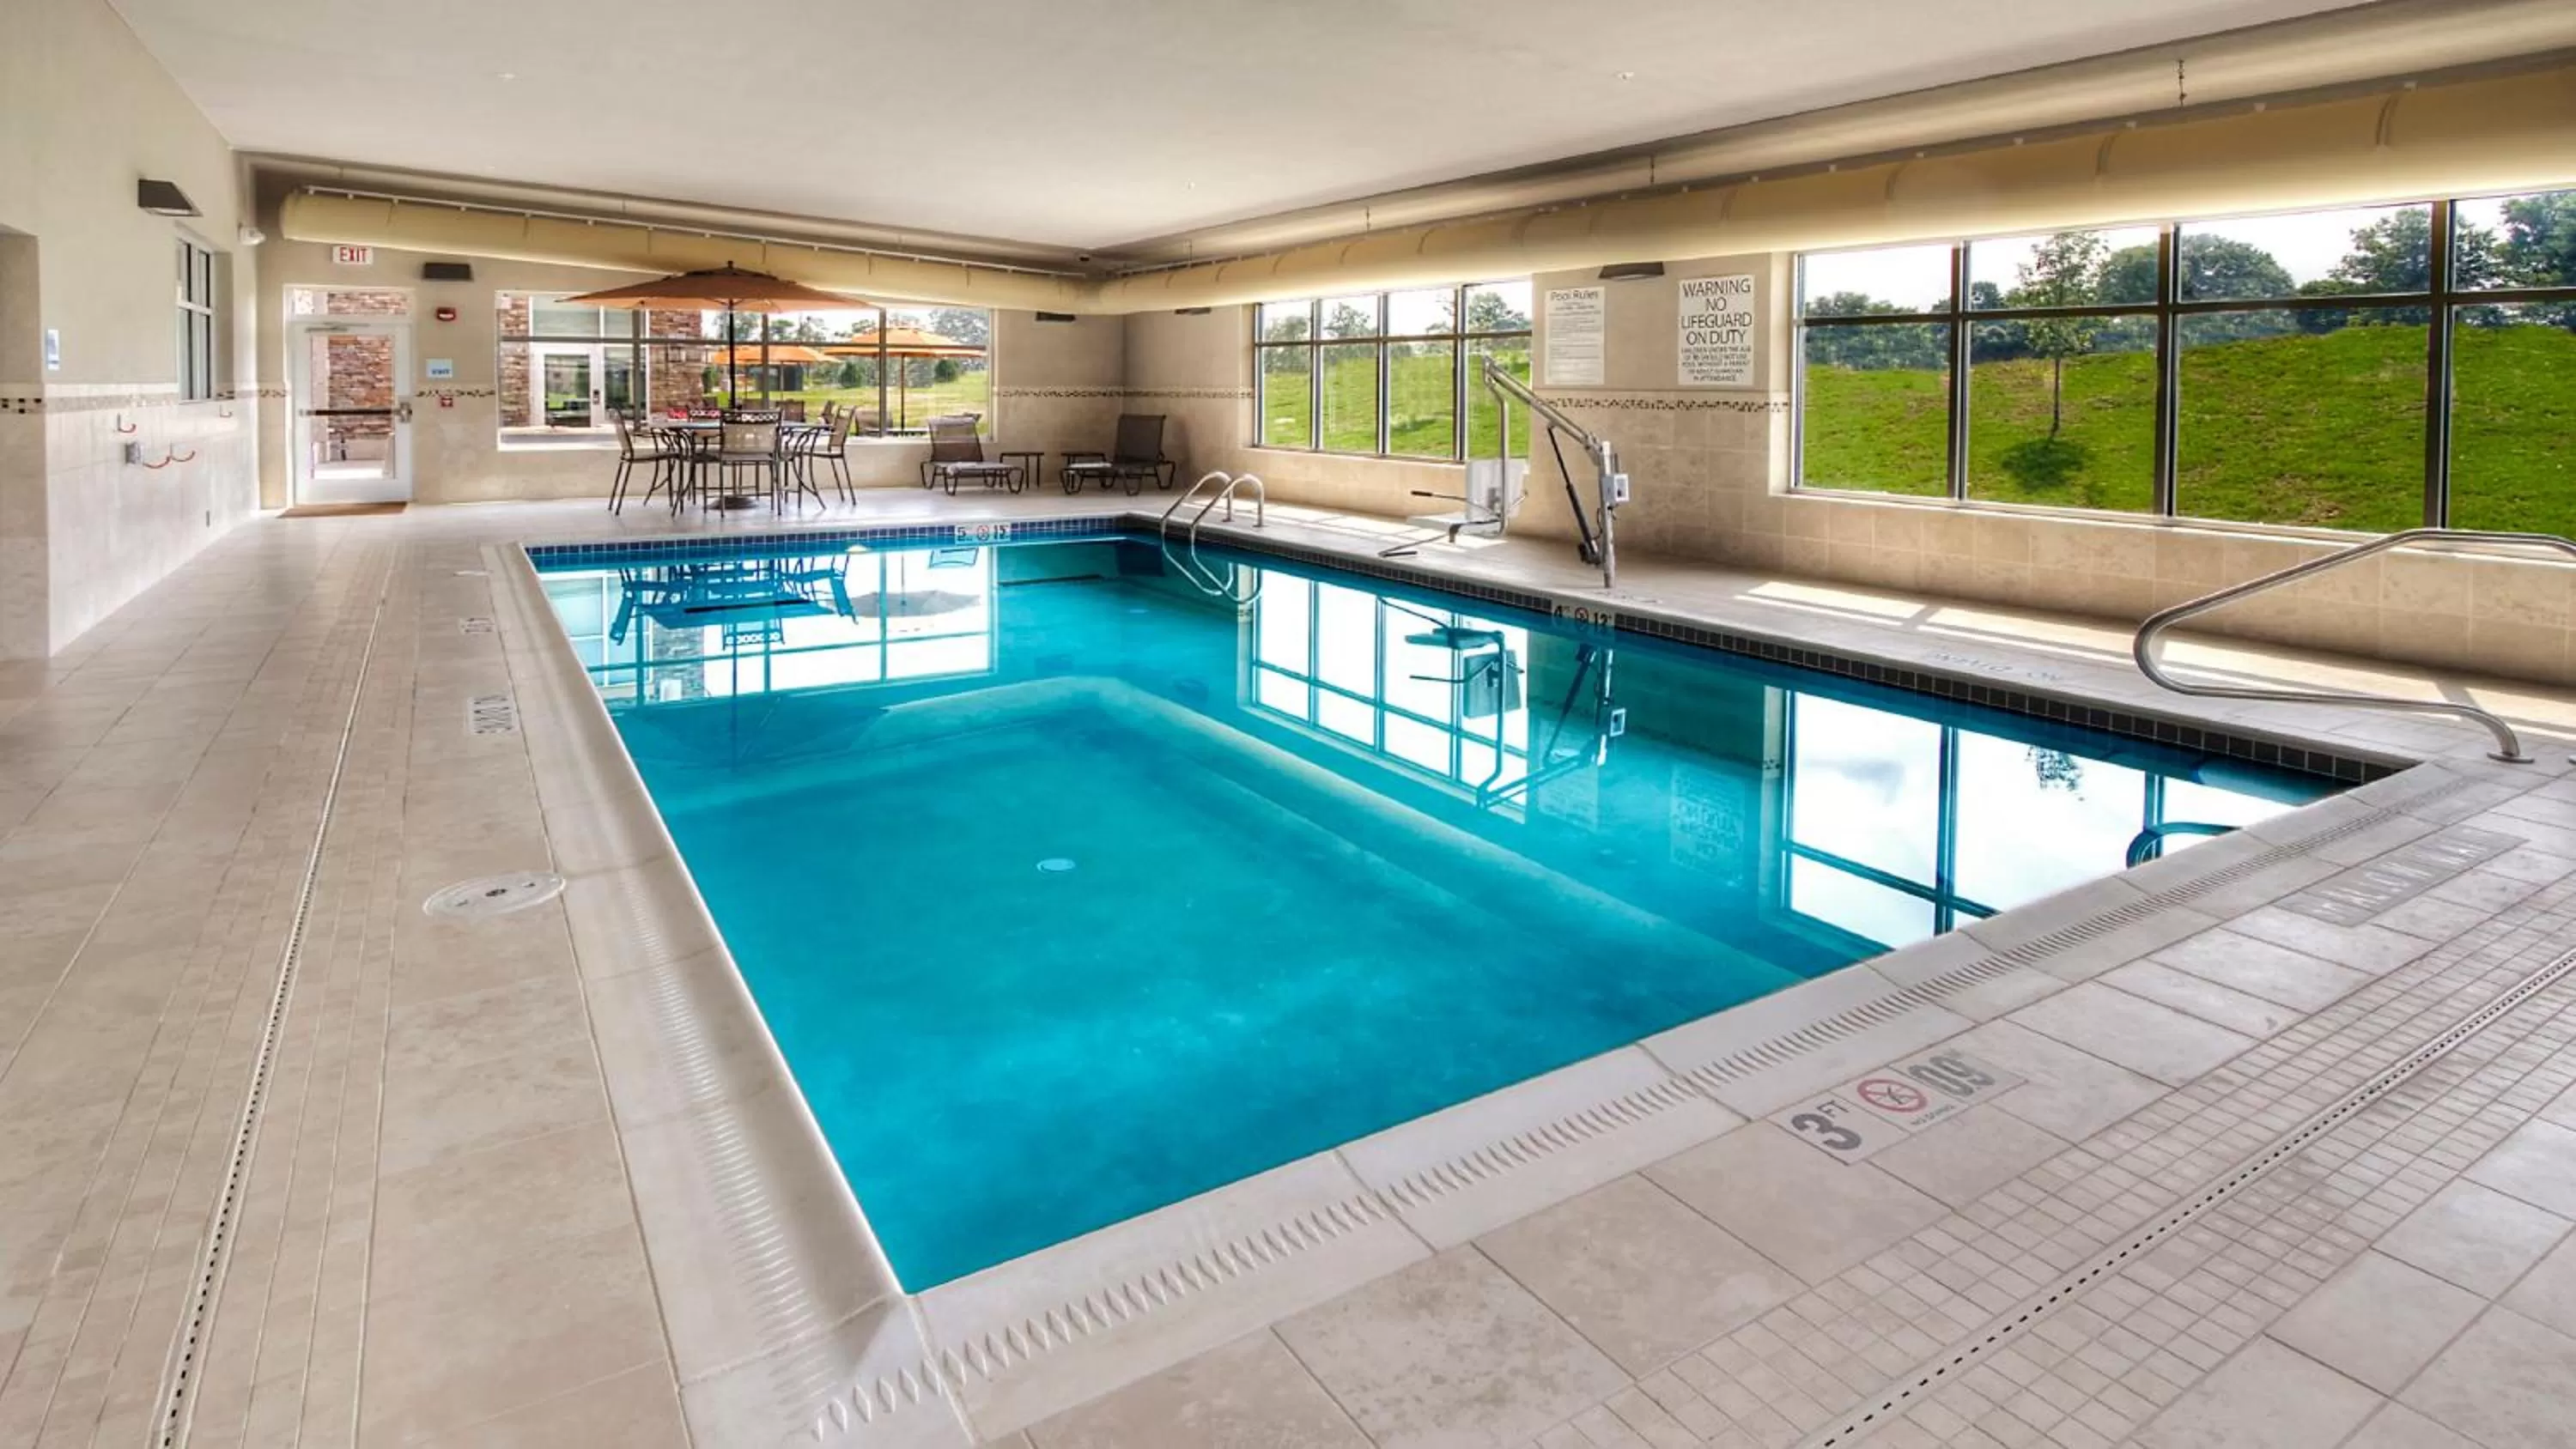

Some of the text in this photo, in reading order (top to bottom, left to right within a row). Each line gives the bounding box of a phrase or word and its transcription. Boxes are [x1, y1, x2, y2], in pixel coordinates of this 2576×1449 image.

[339, 246, 368, 263] EXIT
[1682, 278, 1751, 297] WARNING
[1705, 296, 1727, 312] NO
[1680, 312, 1753, 329] LIFEGUARD
[1686, 329, 1747, 345] ON DUTY
[1816, 1099, 1850, 1118] FT
[1790, 1113, 1862, 1150] 3
